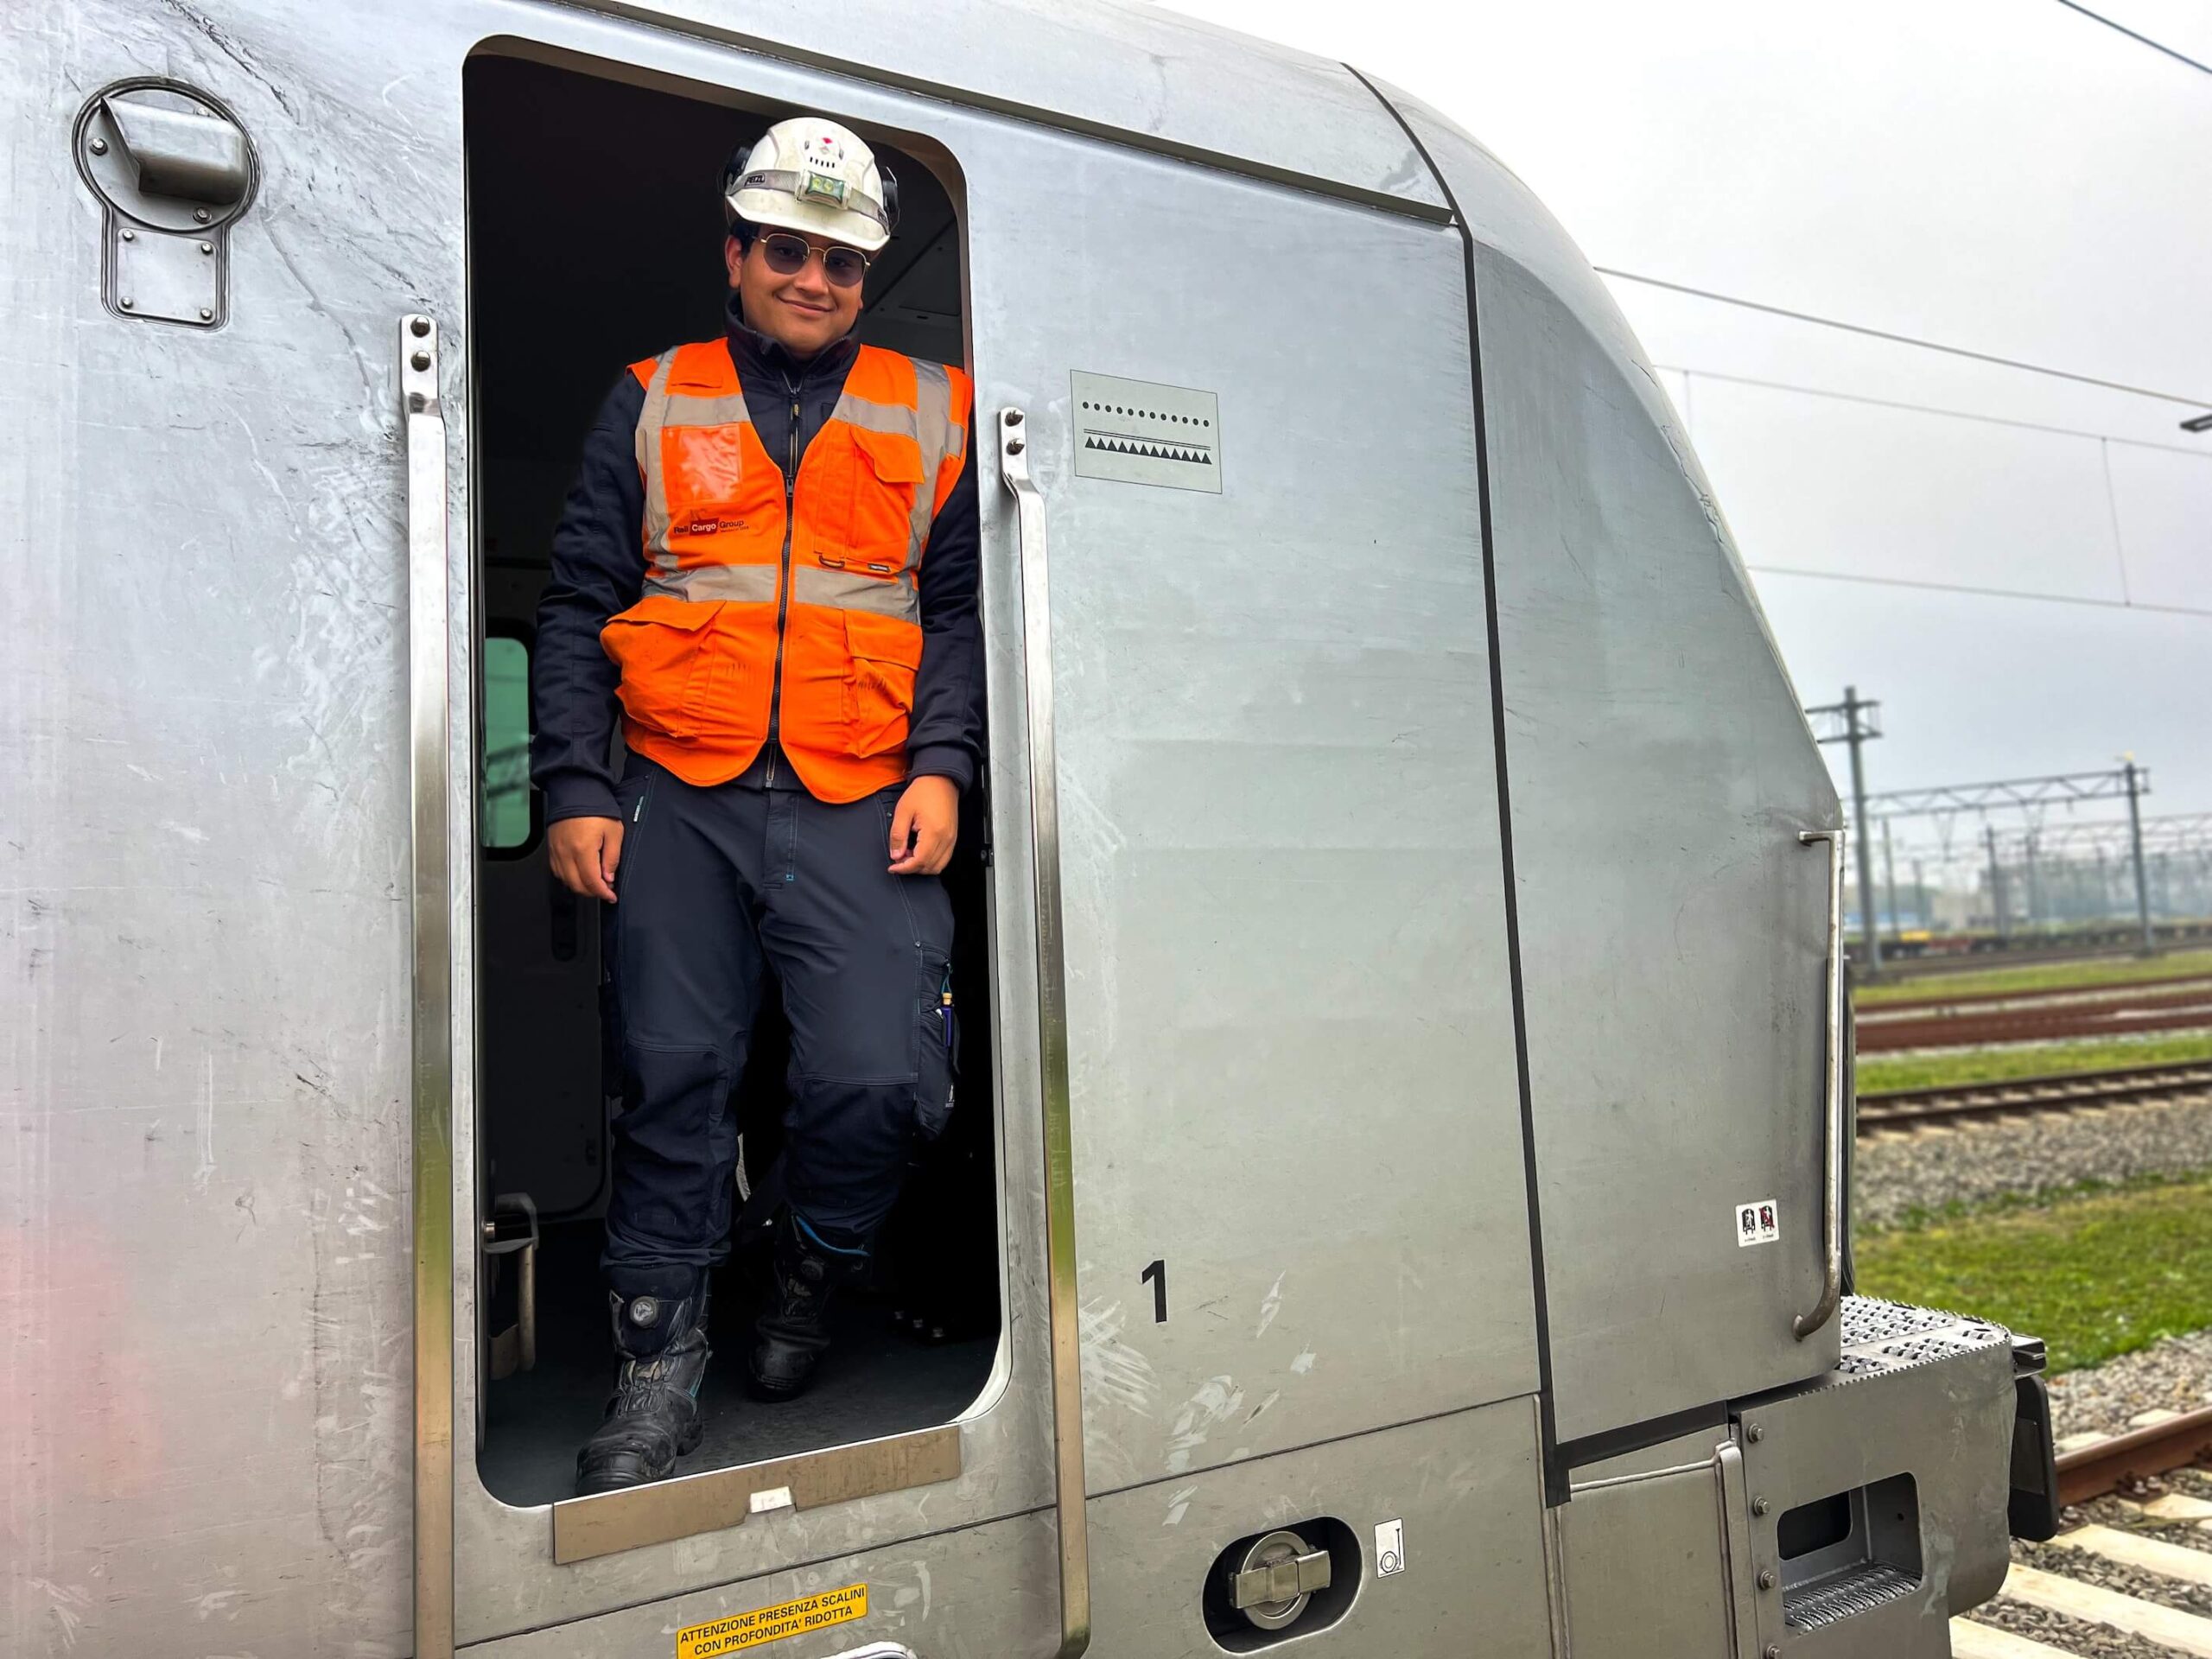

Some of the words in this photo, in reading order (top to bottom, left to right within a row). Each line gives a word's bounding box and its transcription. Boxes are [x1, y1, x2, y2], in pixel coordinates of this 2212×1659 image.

[673, 525, 689, 534] Rail
[691, 524, 716, 532] Cargo
[719, 520, 745, 529] Group
[1141, 1259, 1167, 1324] 1
[680, 1615, 756, 1644] ATTENZIONE
[759, 1599, 819, 1624] PRESENZA
[821, 1586, 865, 1607] SCALINI
[694, 1638, 721, 1656] CON
[724, 1618, 802, 1648] PROFONDITA'
[804, 1605, 853, 1627] RIDOTTA
